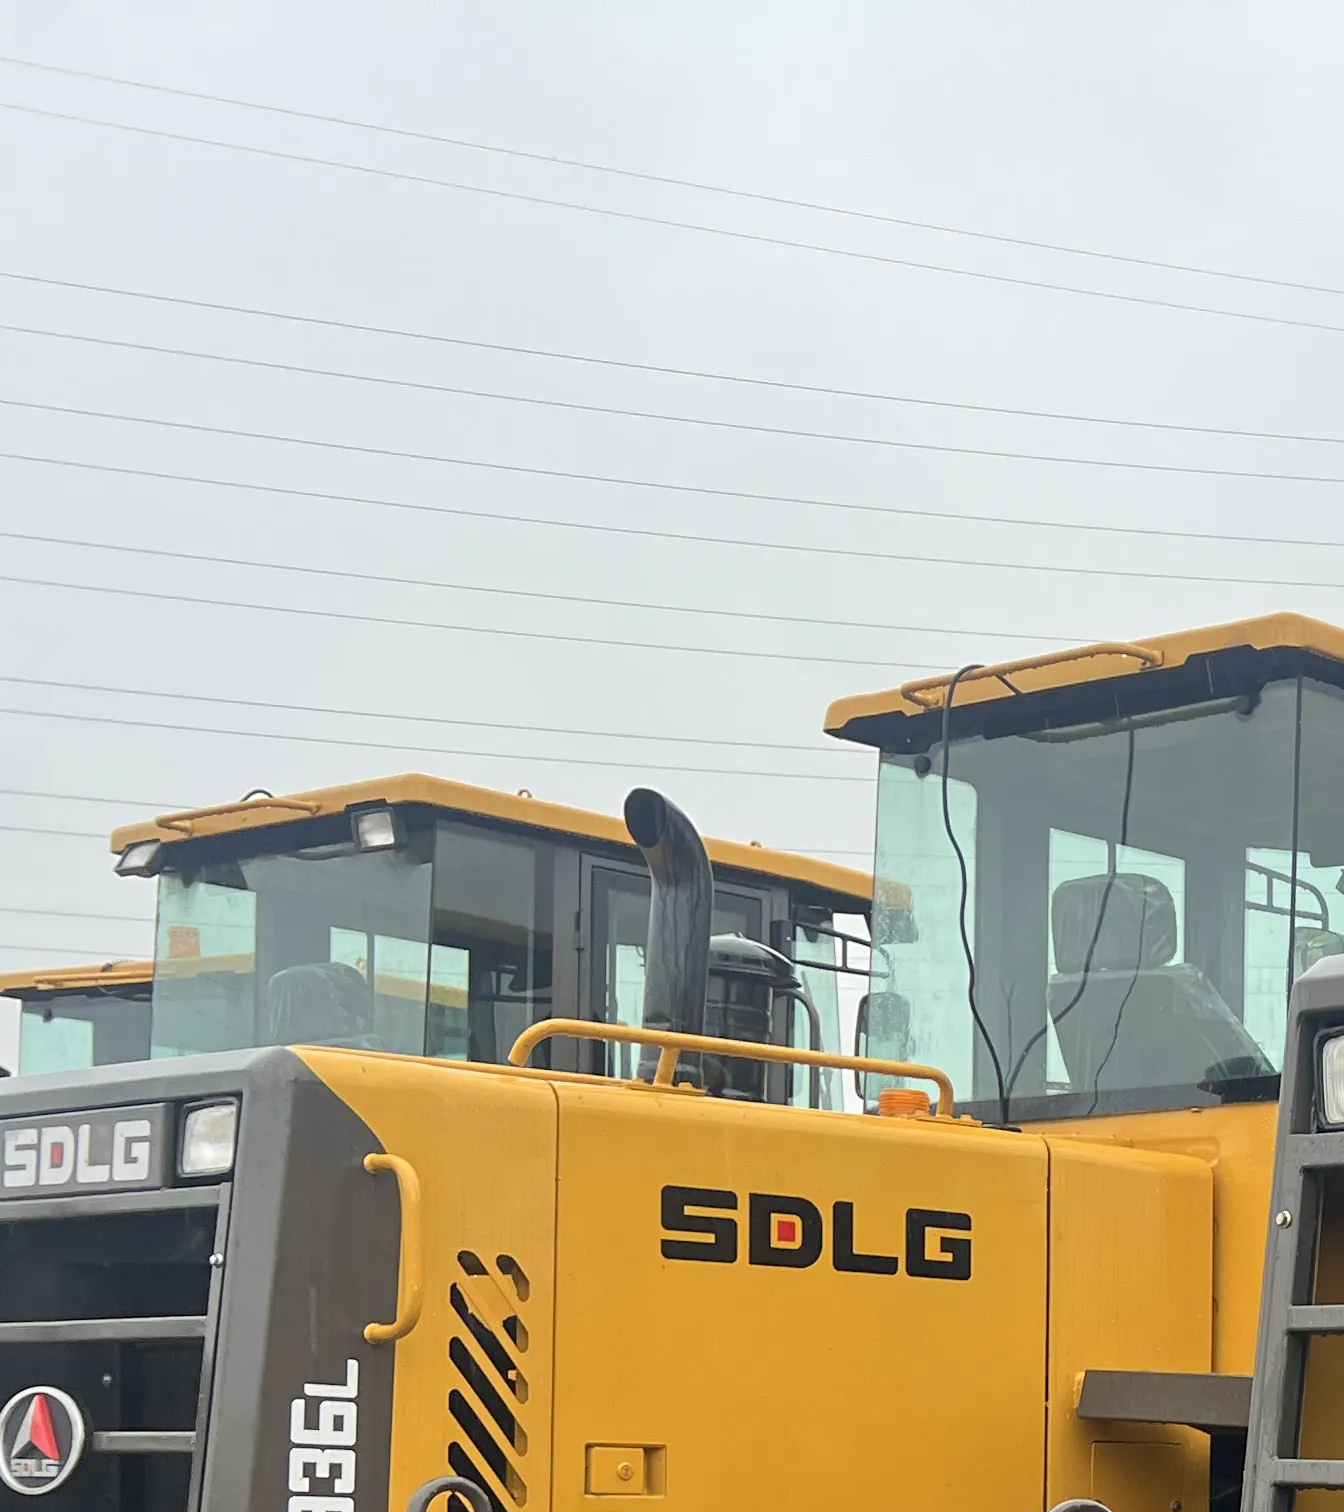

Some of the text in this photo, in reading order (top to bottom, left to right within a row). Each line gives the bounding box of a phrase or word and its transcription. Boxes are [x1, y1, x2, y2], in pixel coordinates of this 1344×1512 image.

[3, 1119, 151, 1188] SDLG
[660, 1184, 972, 1281] SDLG
[9, 1458, 61, 1478] SDLG
